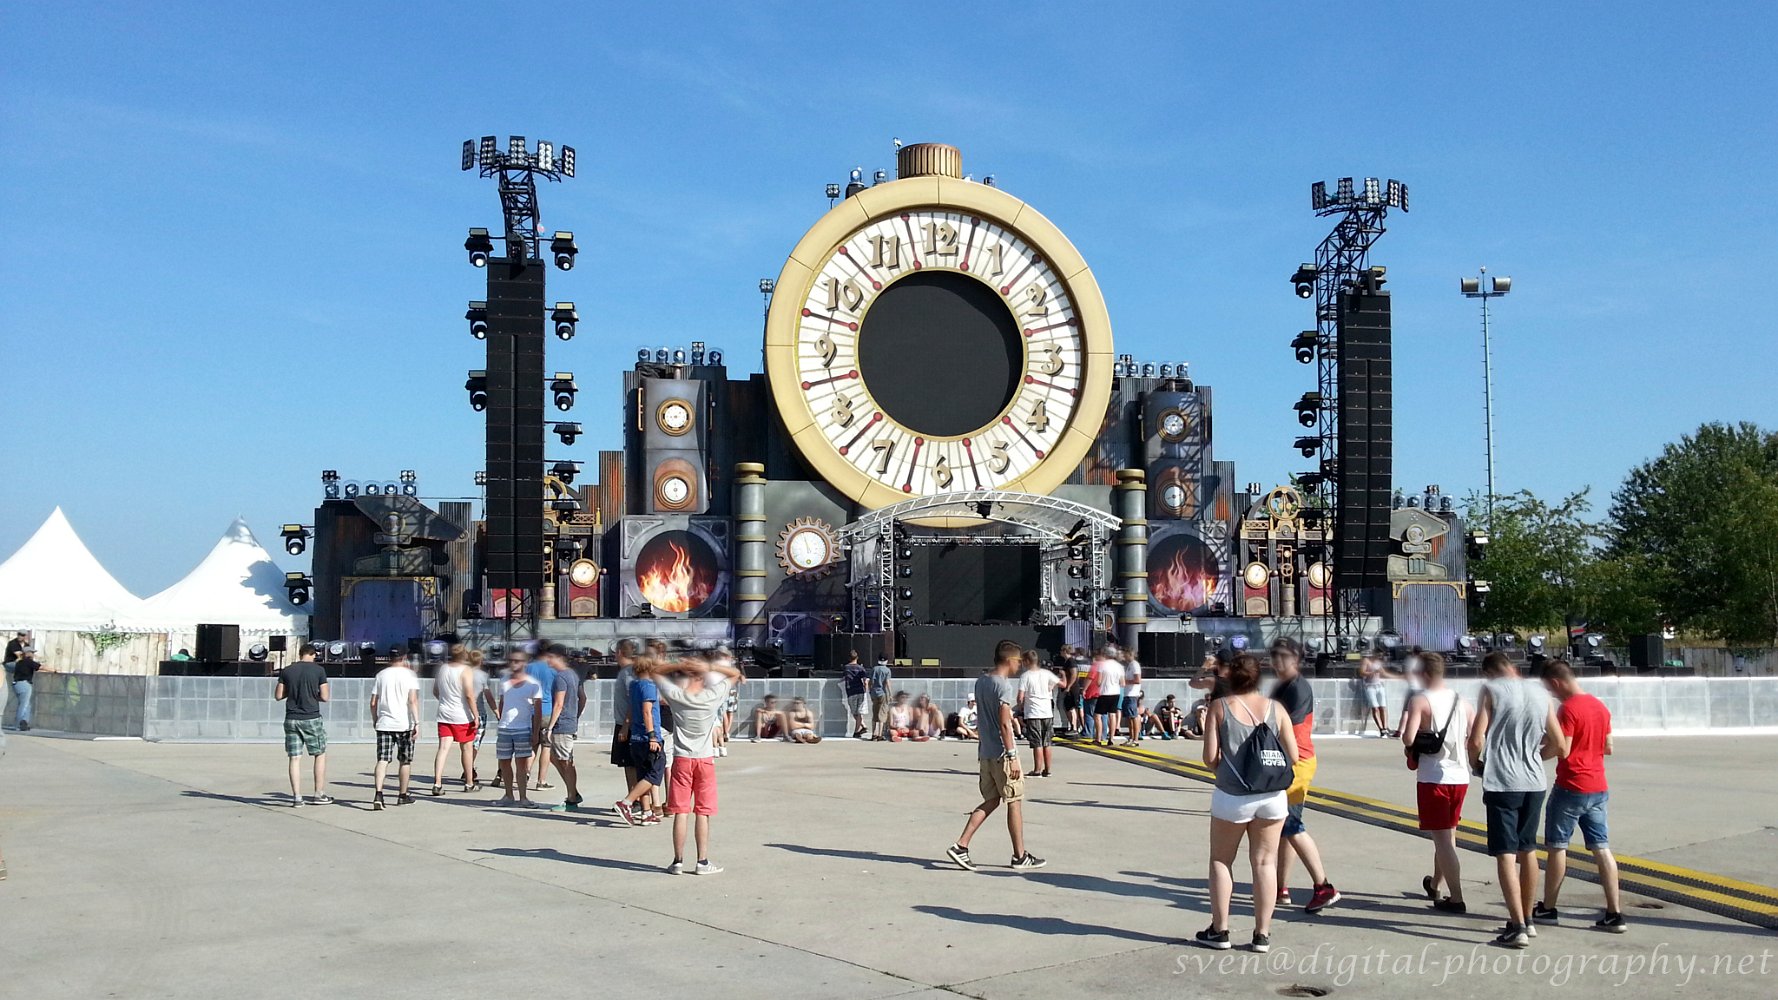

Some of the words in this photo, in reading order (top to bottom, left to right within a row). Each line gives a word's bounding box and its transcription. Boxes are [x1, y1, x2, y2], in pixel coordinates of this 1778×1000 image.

[866, 234, 900, 270] 11
[920, 221, 959, 257] 12
[986, 241, 1004, 277] 1
[821, 277, 864, 313] 10
[1026, 282, 1049, 317] 2
[814, 332, 838, 369] 9
[1041, 342, 1064, 377] 3
[831, 393, 855, 429] 8
[1026, 399, 1050, 434] 4
[872, 438, 895, 475] 7
[931, 455, 953, 489] 6
[988, 439, 1011, 475] 5
[1260, 750, 1285, 759] MIAM
